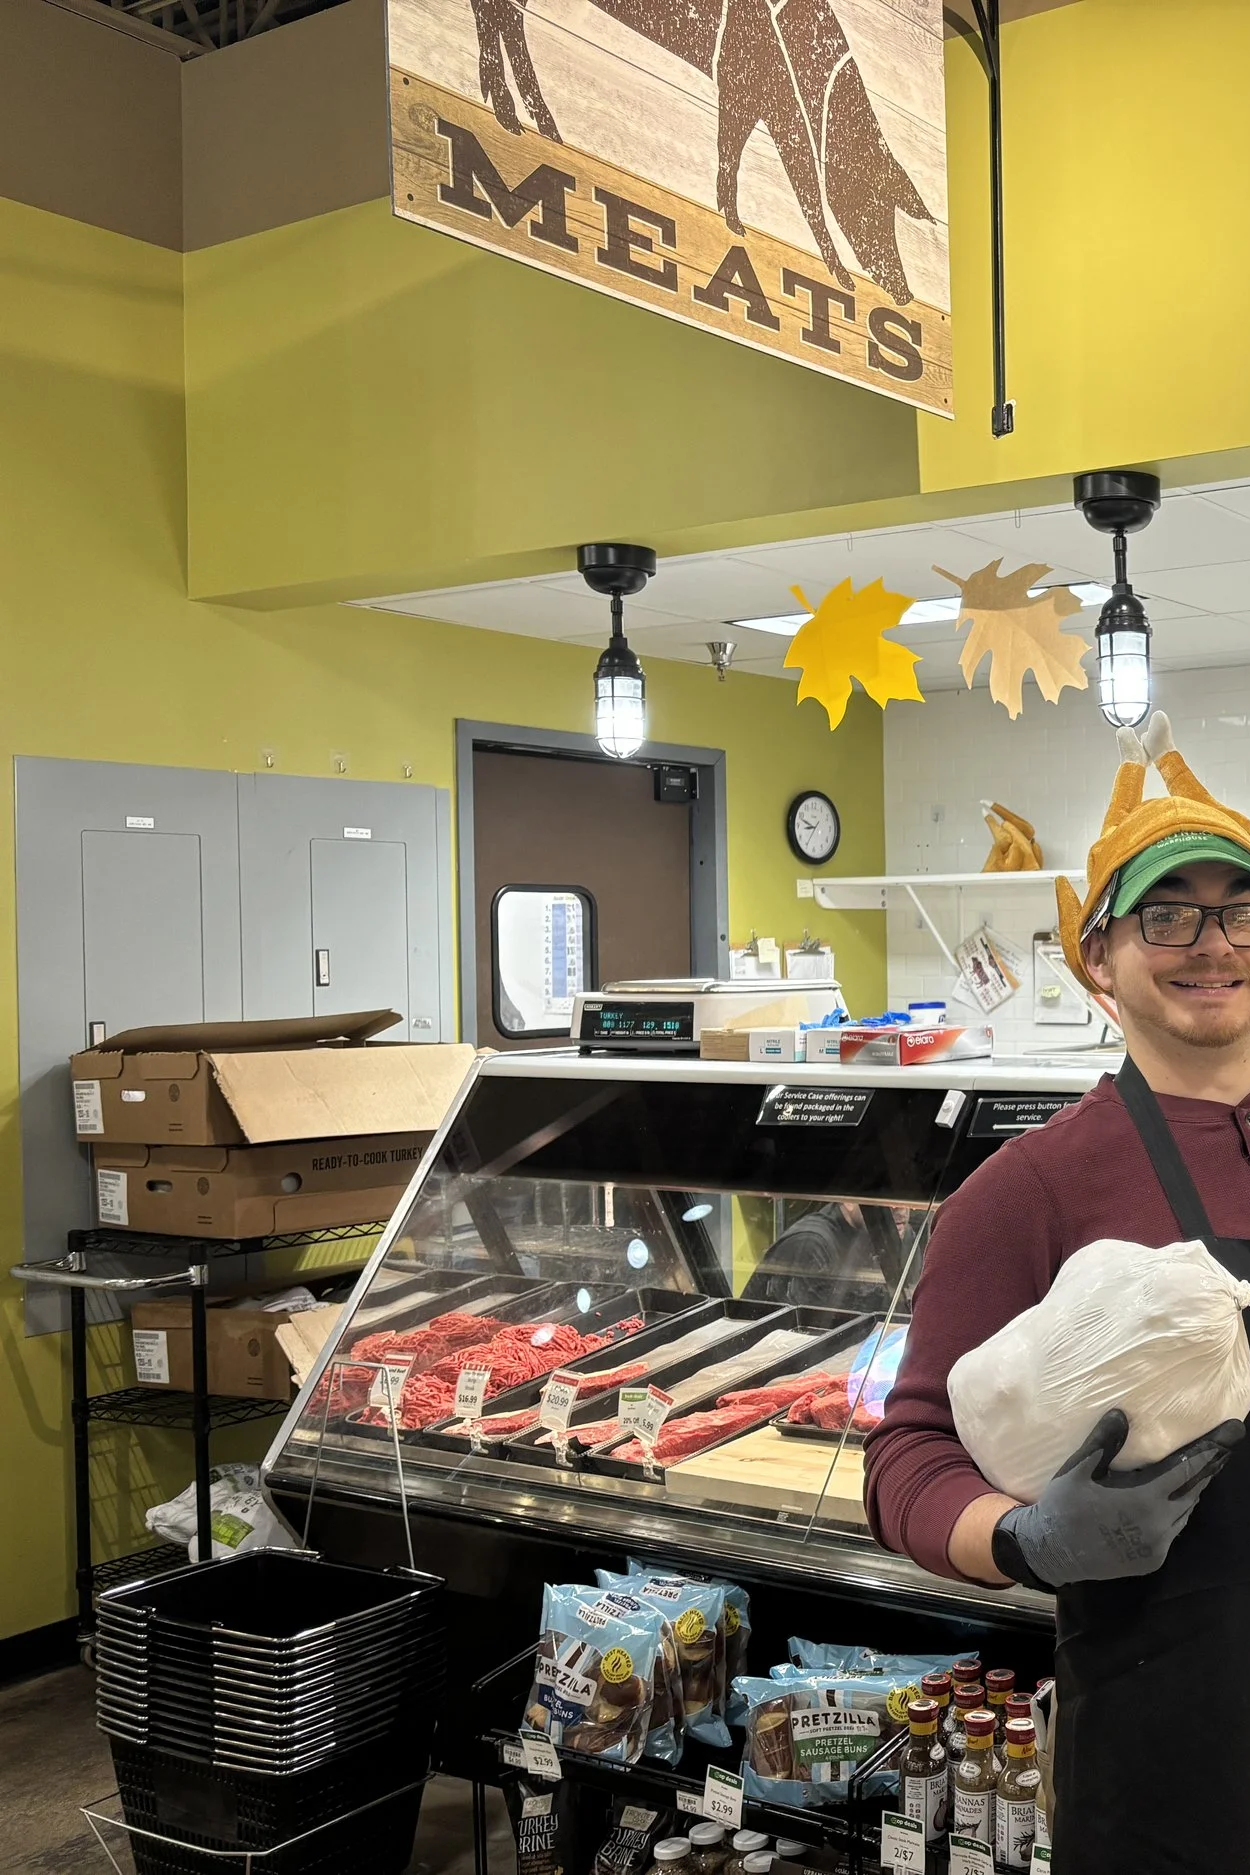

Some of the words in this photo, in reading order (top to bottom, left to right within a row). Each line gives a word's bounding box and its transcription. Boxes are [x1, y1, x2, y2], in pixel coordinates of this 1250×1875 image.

[435, 118, 924, 382] MEATS
[808, 1092, 823, 1100] Case
[824, 1093, 853, 1102] offerings
[784, 1101, 803, 1110] found
[803, 1103, 835, 1112] packaged
[992, 1103, 1016, 1111] Please
[1037, 1102, 1062, 1110] button
[777, 1113, 800, 1121] coolers
[825, 1114, 844, 1123] right!
[1016, 1113, 1043, 1121] service.
[312, 1150, 389, 1172] READY-TO-COOK
[389, 1147, 423, 1167] TURKEY
[458, 1393, 478, 1405] $16.99
[547, 1393, 569, 1407] $20.99
[792, 1711, 877, 1730] PRETZILLA
[815, 1737, 853, 1746] PRETZEL
[800, 1746, 843, 1757] SAUSAGE
[844, 1745, 868, 1754] BUNS
[533, 1754, 554, 1767] $2.99
[711, 1800, 733, 1816] $2.99
[904, 1819, 918, 1830] deals
[611, 1827, 650, 1850] TURKEY
[600, 1840, 640, 1867] BRINE
[893, 1847, 914, 1861] 2/$7
